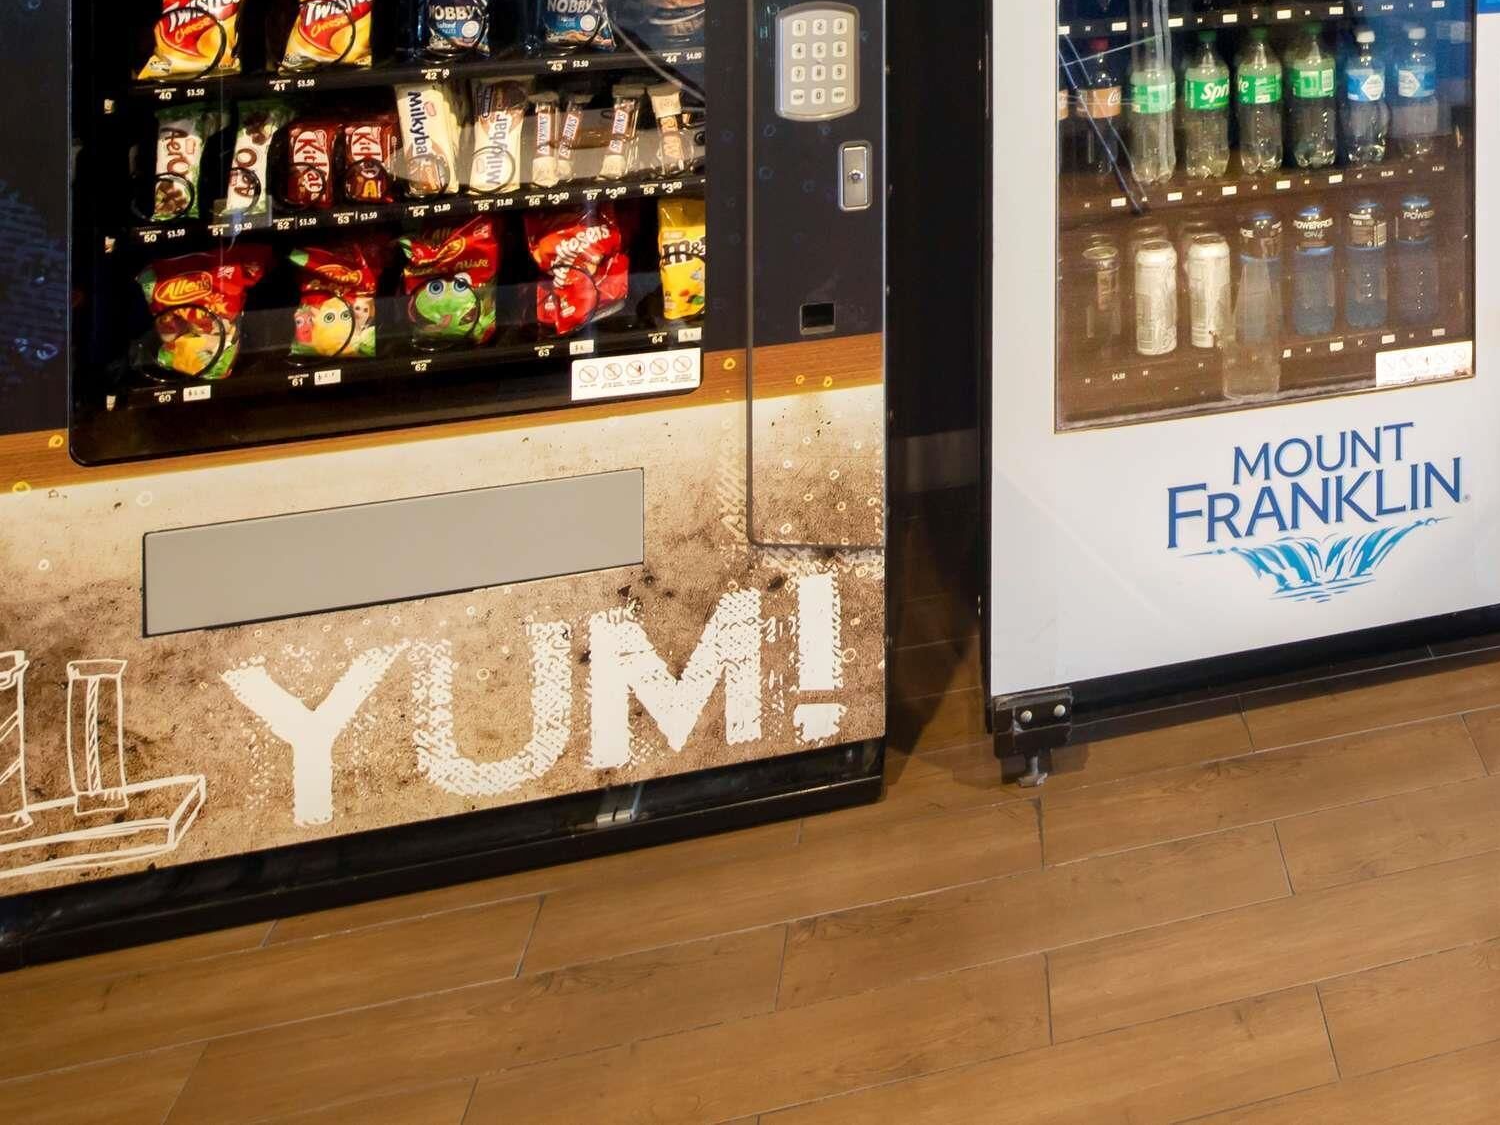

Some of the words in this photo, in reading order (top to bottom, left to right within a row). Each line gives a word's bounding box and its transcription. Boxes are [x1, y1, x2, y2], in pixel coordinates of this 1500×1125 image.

[551, 62, 563, 72] 43
[425, 71, 437, 81] 42
[273, 83, 286, 92] 41
[1200, 77, 1230, 104] Spri
[159, 91, 172, 100] 40
[407, 91, 431, 156] Milkyba
[586, 192, 598, 201] 57
[529, 198, 541, 206] 56
[413, 208, 425, 217] 54
[337, 215, 350, 224] 53
[278, 221, 290, 230] 52
[212, 228, 224, 236] 51
[143, 234, 157, 243] 50
[160, 275, 212, 299] Allen's
[652, 335, 663, 344] 64
[538, 348, 550, 357] 63
[415, 363, 427, 372] 62
[292, 378, 304, 386] 61
[158, 394, 172, 403] 60
[1233, 422, 1414, 485] MOUNT
[1167, 457, 1462, 549] FRANKLIN
[221, 567, 848, 827] YUM!
